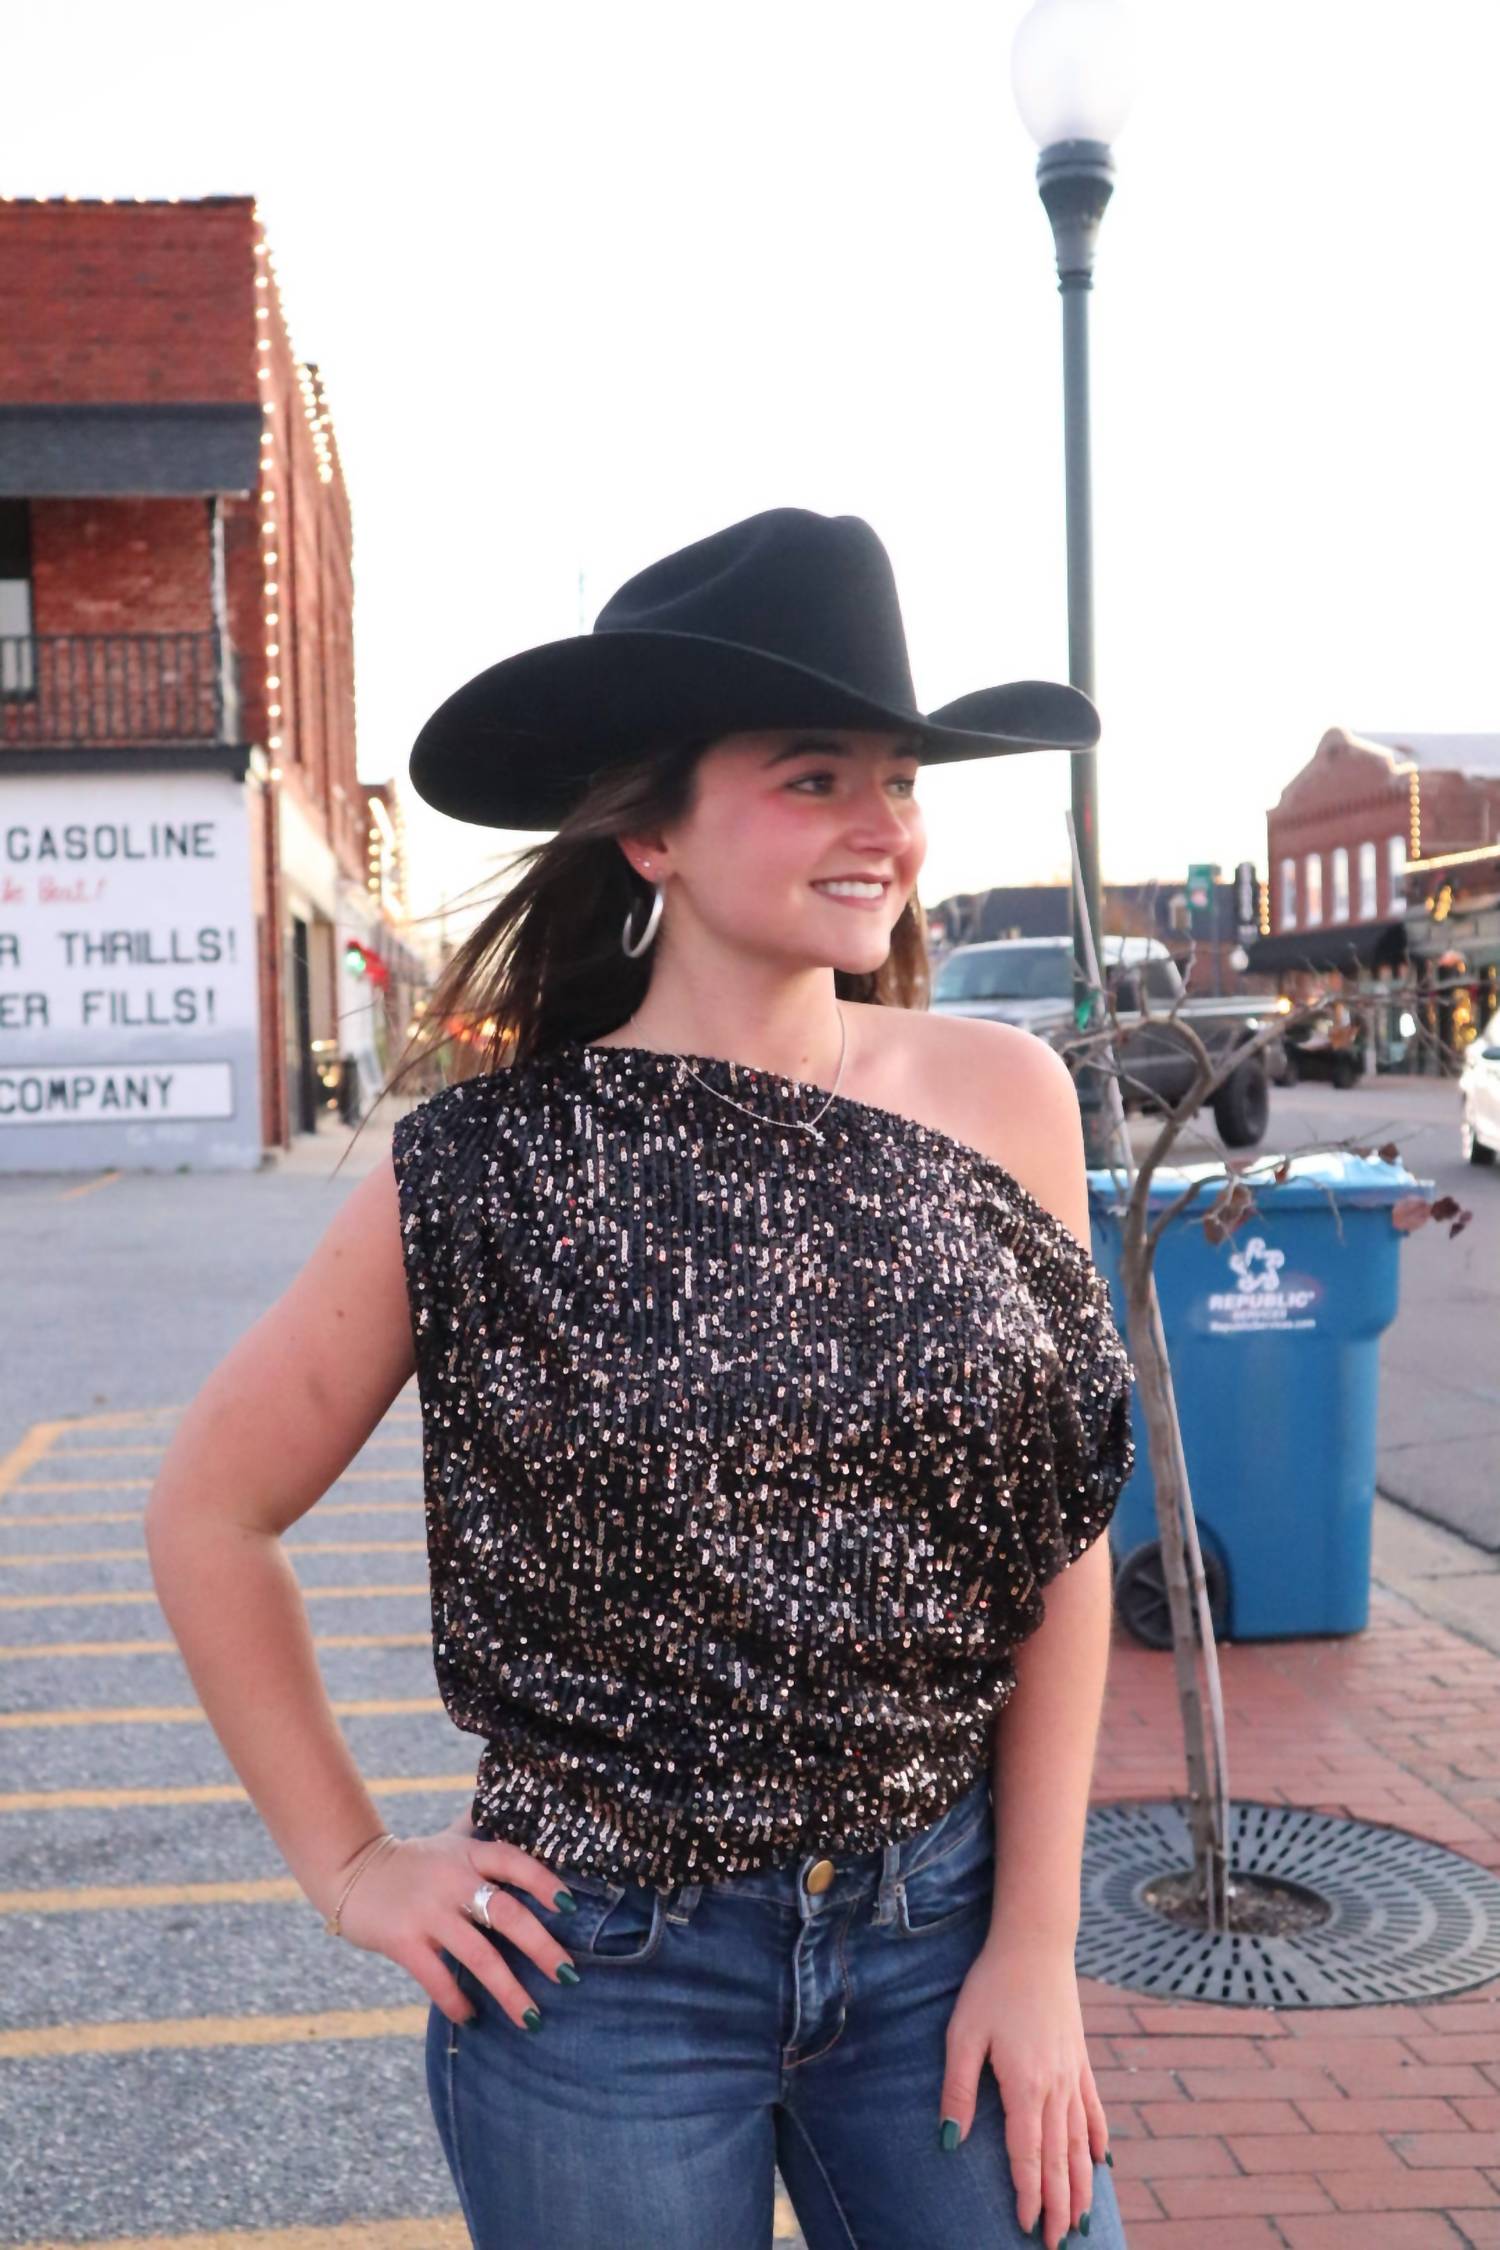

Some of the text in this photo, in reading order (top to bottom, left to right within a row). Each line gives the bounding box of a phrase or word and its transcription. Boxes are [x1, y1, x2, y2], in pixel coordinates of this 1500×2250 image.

[6, 822, 216, 863] GASOLINE
[59, 928, 235, 967] THRILLS!
[81, 988, 216, 1027] FILLS!
[0, 1075, 174, 1115] COMPANY
